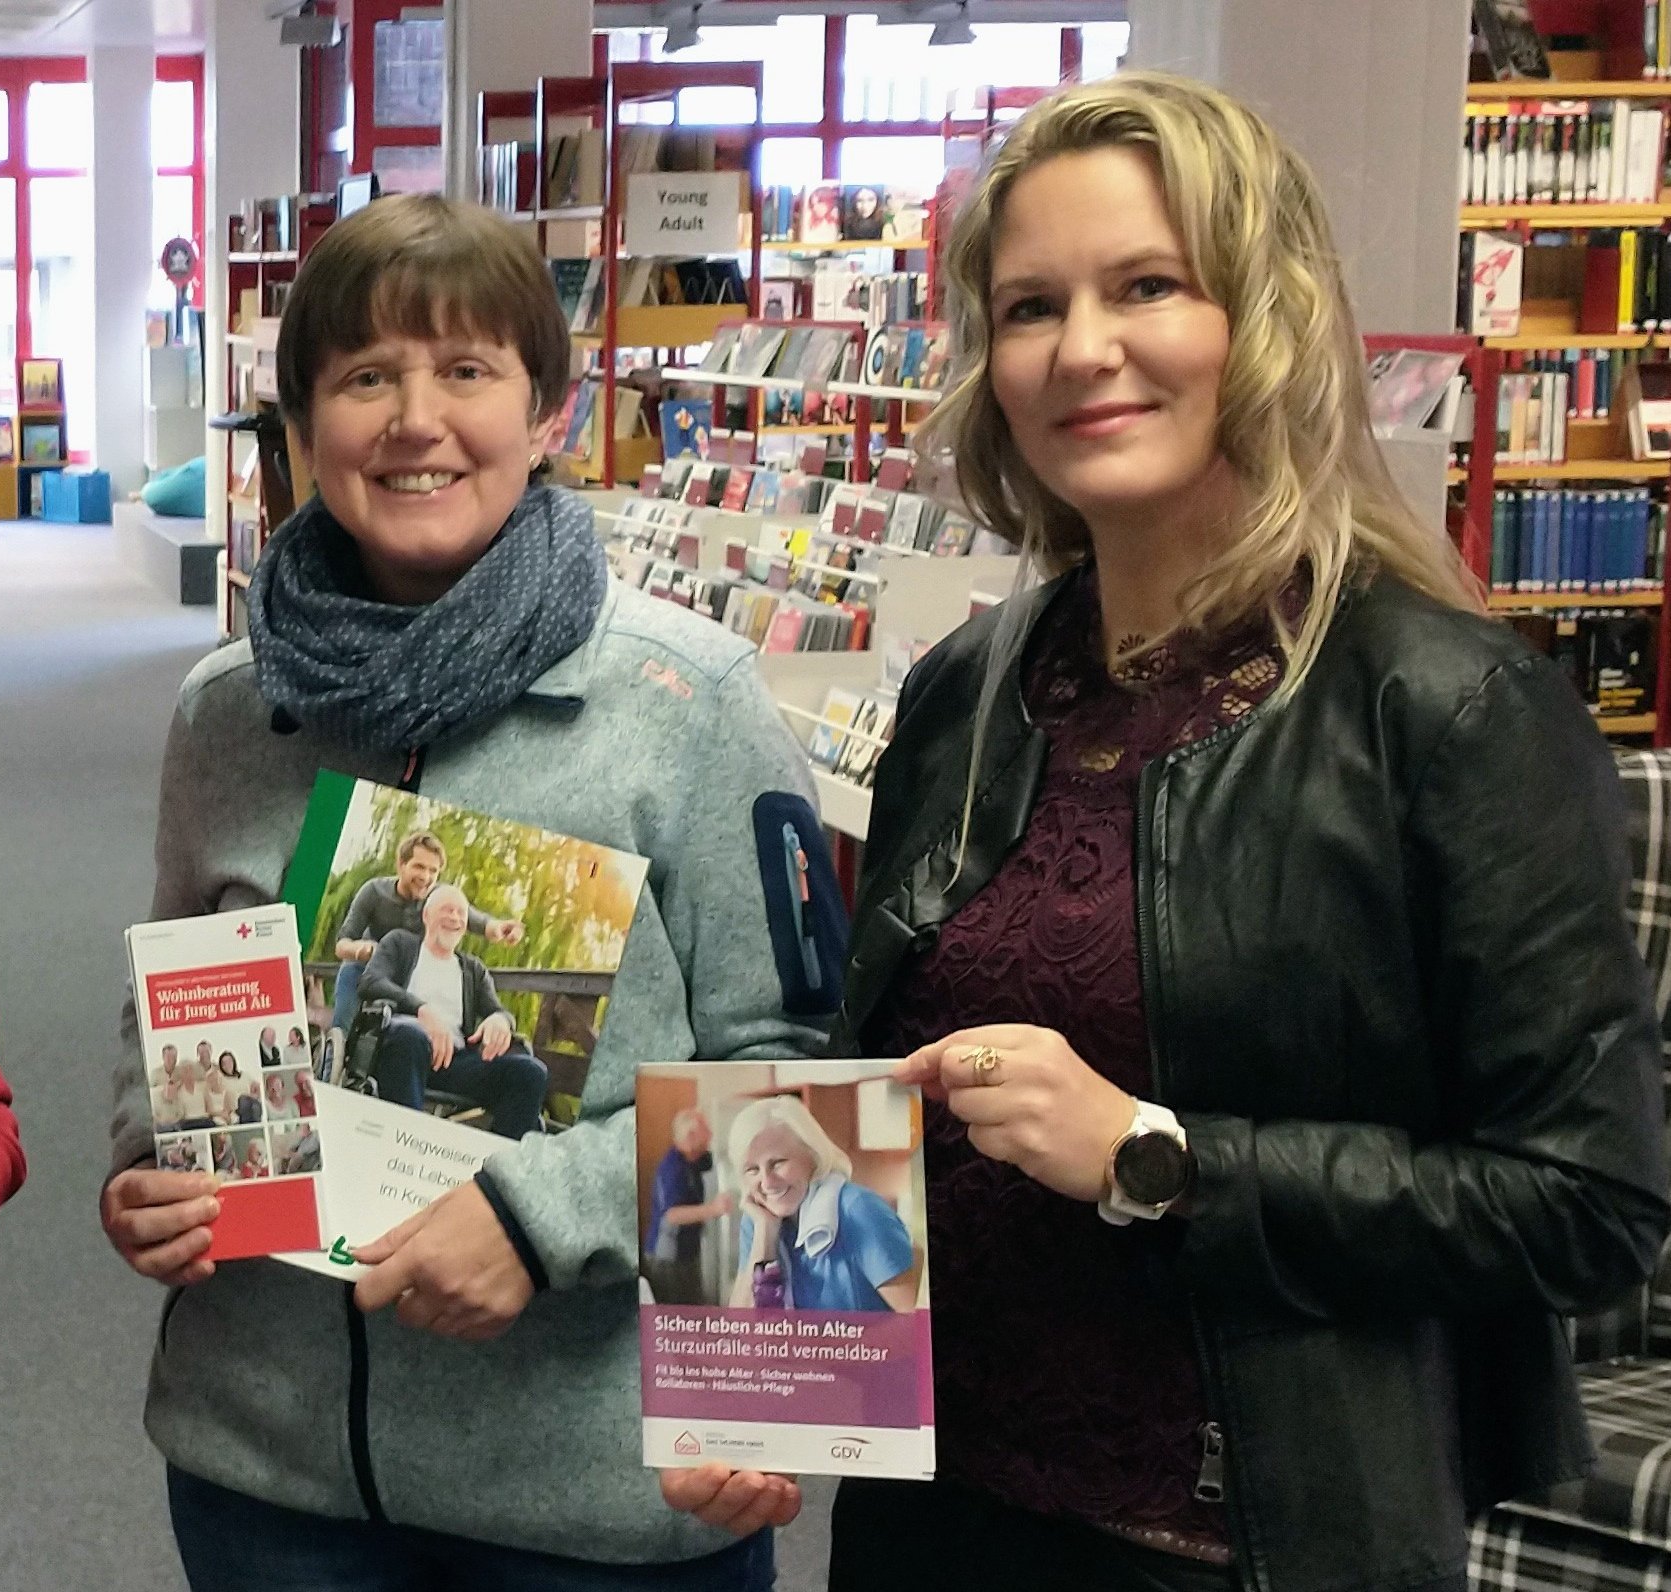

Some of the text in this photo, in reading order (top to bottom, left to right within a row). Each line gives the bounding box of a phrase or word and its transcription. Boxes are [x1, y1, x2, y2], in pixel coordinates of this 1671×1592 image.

[657, 190, 708, 207] Young
[659, 216, 704, 231] Adult
[156, 979, 261, 1006] Wohnberatung
[159, 993, 272, 1022] für Jung und Alt
[395, 1127, 478, 1166] Wegweiser
[387, 1157, 461, 1188] das Lebe
[379, 1182, 398, 1198] im
[654, 1315, 864, 1338] Sicher leben auch im Alter
[654, 1336, 889, 1361] Sturzunfälle sind vermeidbar
[760, 1368, 792, 1380] Sicher
[793, 1370, 835, 1382] wohnen
[762, 1381, 796, 1396] Pflege
[831, 1446, 862, 1460] GDV
